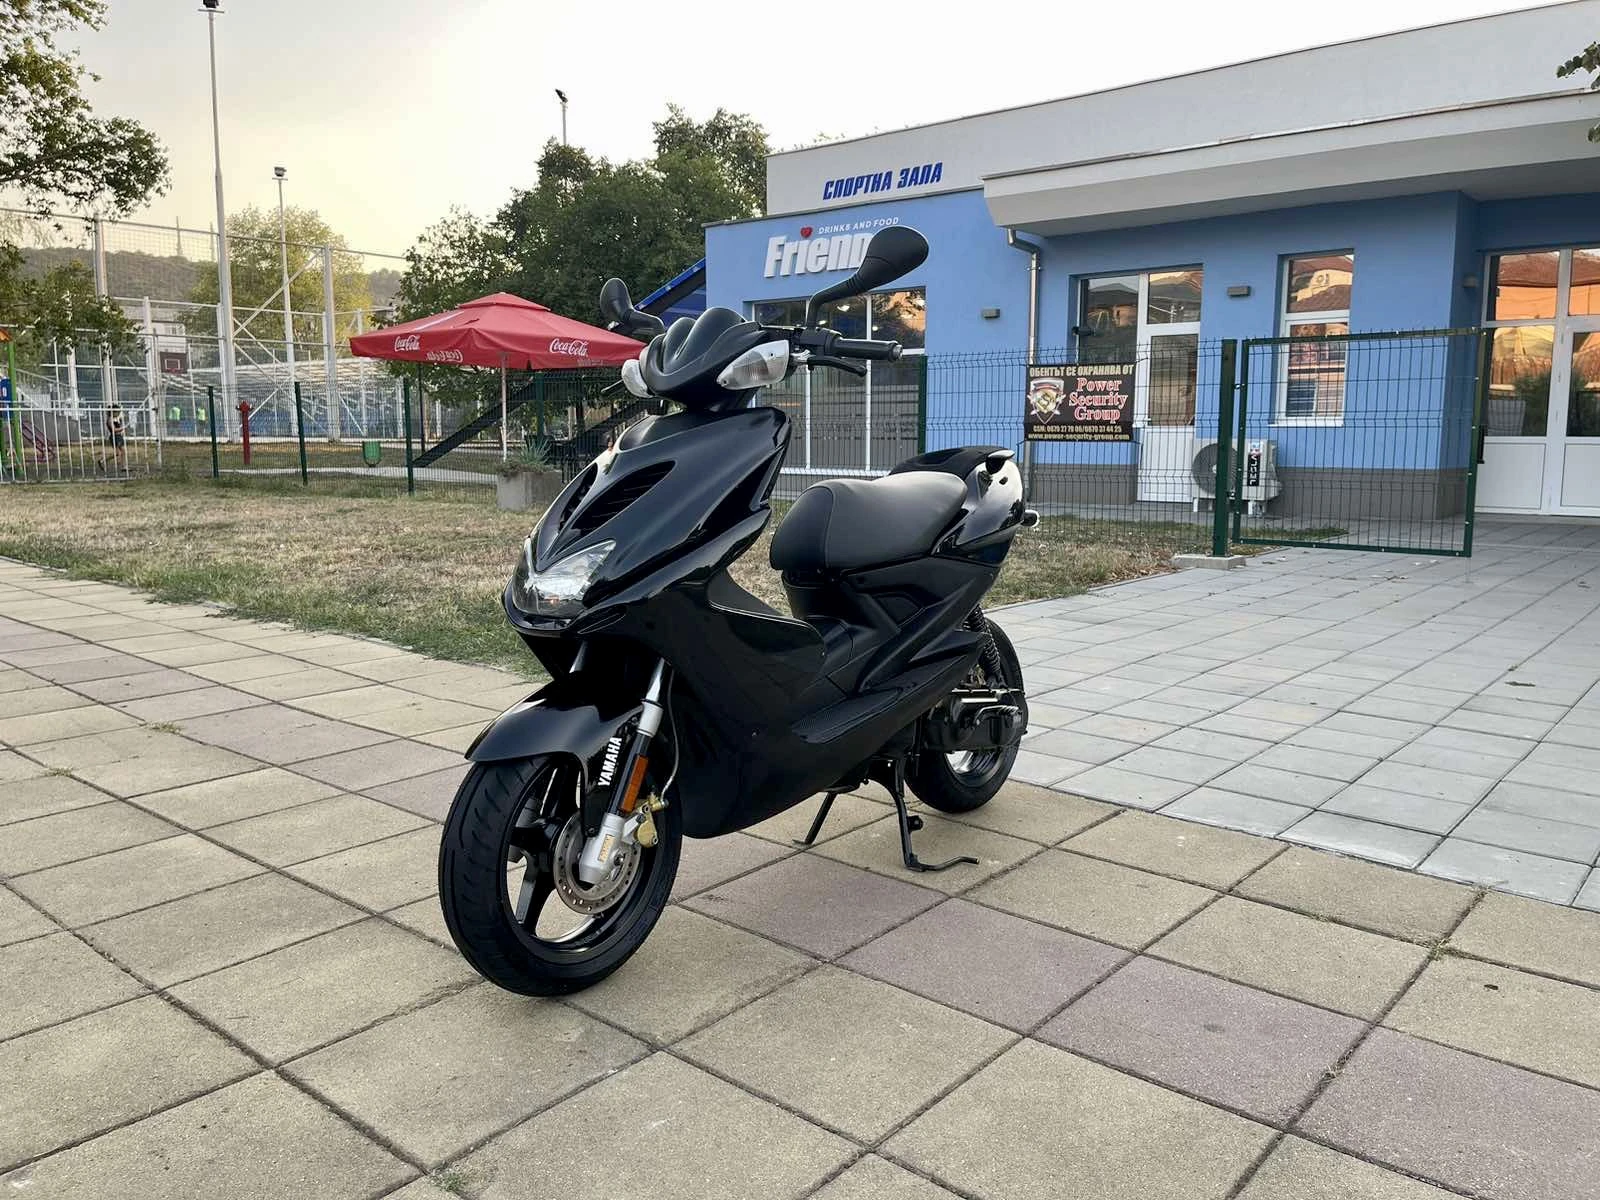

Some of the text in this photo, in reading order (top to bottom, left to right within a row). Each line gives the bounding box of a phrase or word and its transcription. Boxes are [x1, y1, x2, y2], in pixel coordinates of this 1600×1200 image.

[822, 171, 893, 200] СПОРТНА
[818, 217, 899, 234] DRINKS AND FOOD
[394, 335, 420, 352] Coca-Cola
[549, 338, 588, 357] Coca-Cola
[1066, 366, 1077, 377] СЕ
[1122, 364, 1134, 375] ОТ
[1076, 377, 1122, 392] Power
[1069, 391, 1128, 409] Security
[1074, 406, 1120, 424] Group
[597, 737, 622, 786] YAMAHA
